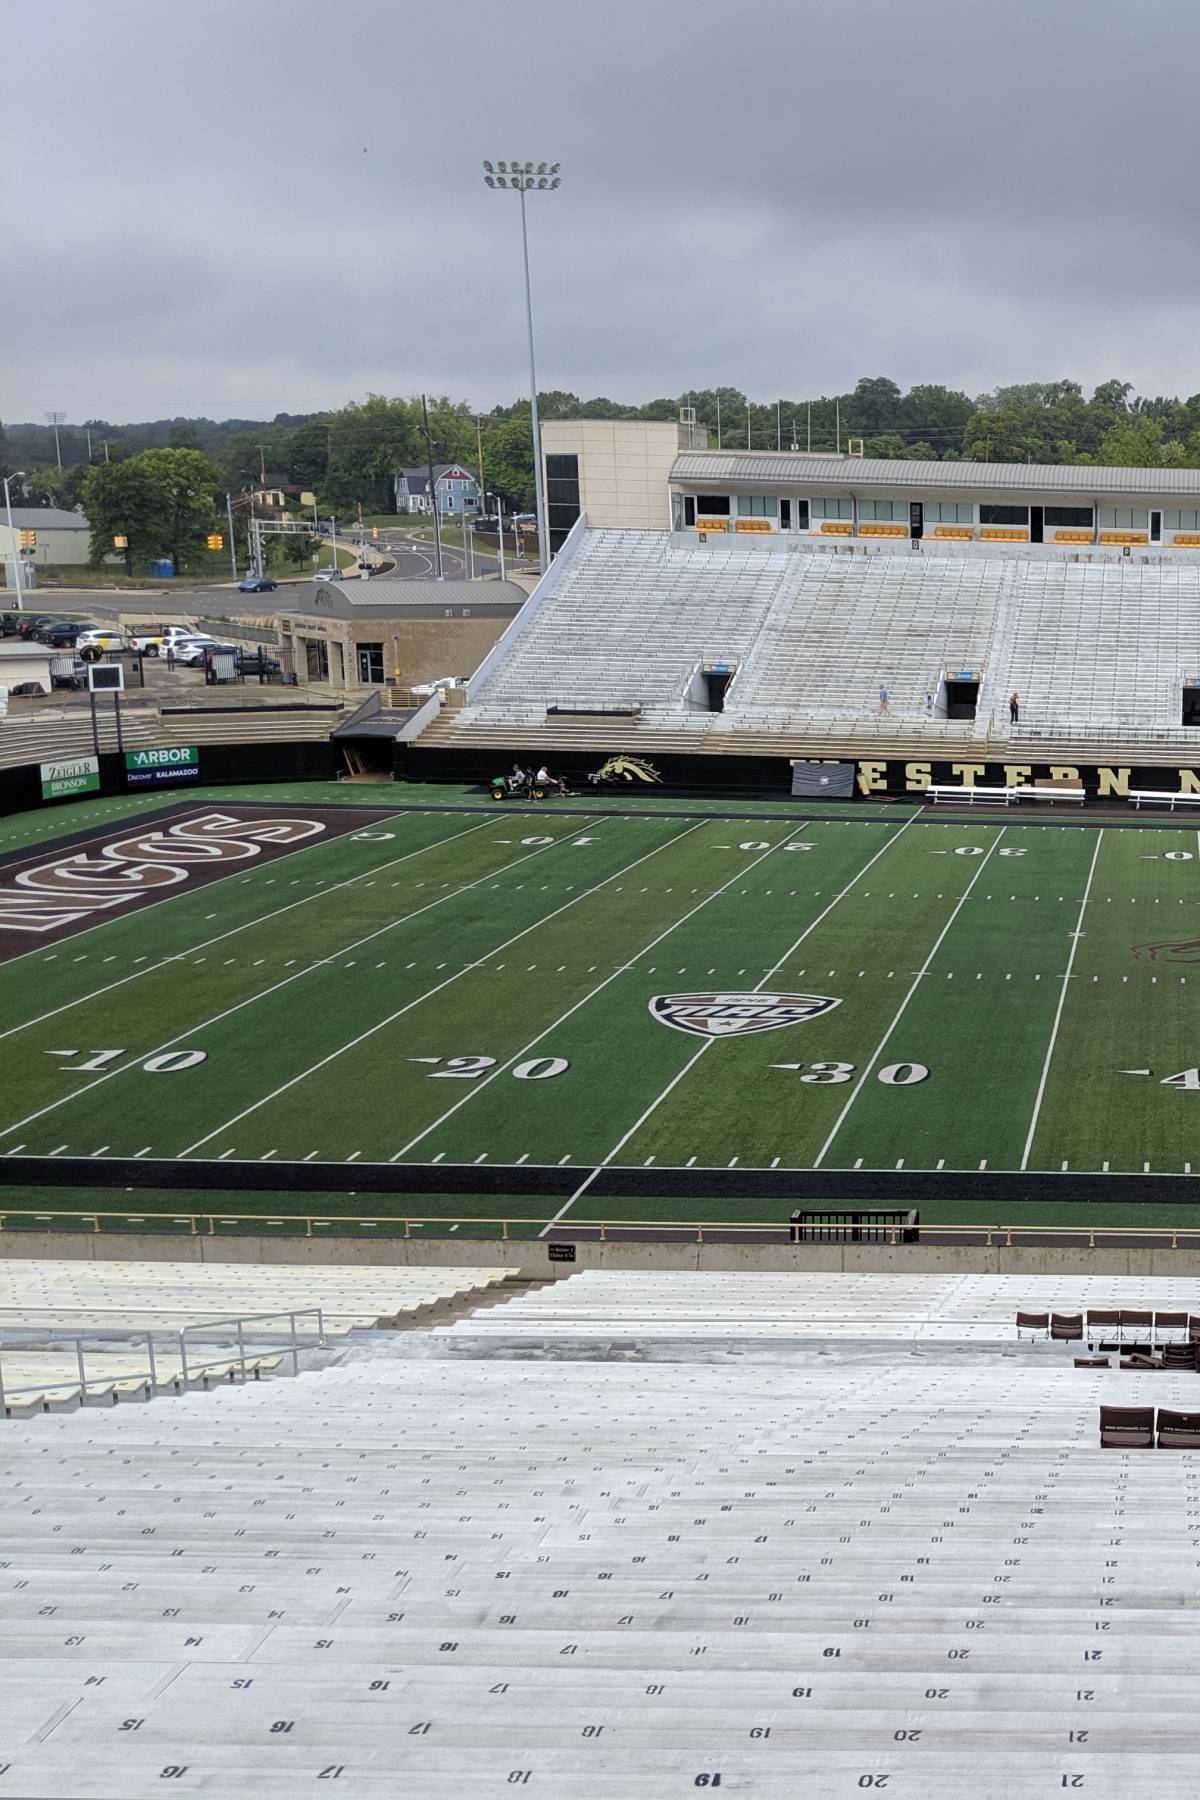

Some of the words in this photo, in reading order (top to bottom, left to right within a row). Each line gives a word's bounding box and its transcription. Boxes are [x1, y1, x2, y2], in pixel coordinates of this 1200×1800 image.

[136, 748, 190, 765] ARBOR
[48, 761, 91, 780] ZEIGLER
[156, 769, 198, 779] KALAMAZOO
[51, 777, 87, 791] BRONSON
[789, 760, 1132, 796] ESTEN
[659, 1005, 816, 1017] MAC
[59, 1049, 207, 1073] 10
[427, 1056, 569, 1081] 20
[800, 1062, 929, 1085] 30
[822, 1647, 841, 1658] 19
[947, 1649, 970, 1660] 20
[1084, 1650, 1103, 1661] 21
[83, 1675, 107, 1687] 14
[229, 1678, 254, 1689] 15
[487, 1682, 510, 1694] 17
[791, 1687, 813, 1698] 19
[924, 1688, 950, 1700] 20
[1076, 1690, 1095, 1701] 21
[117, 1718, 146, 1731] 15
[407, 1722, 433, 1735] 17
[749, 1726, 772, 1739] 19
[893, 1729, 923, 1742] 20
[1068, 1730, 1089, 1744] 21
[316, 1765, 345, 1779] 17
[693, 1772, 722, 1788] 19
[857, 1774, 891, 1788] 20
[1061, 1774, 1085, 1788] 21
